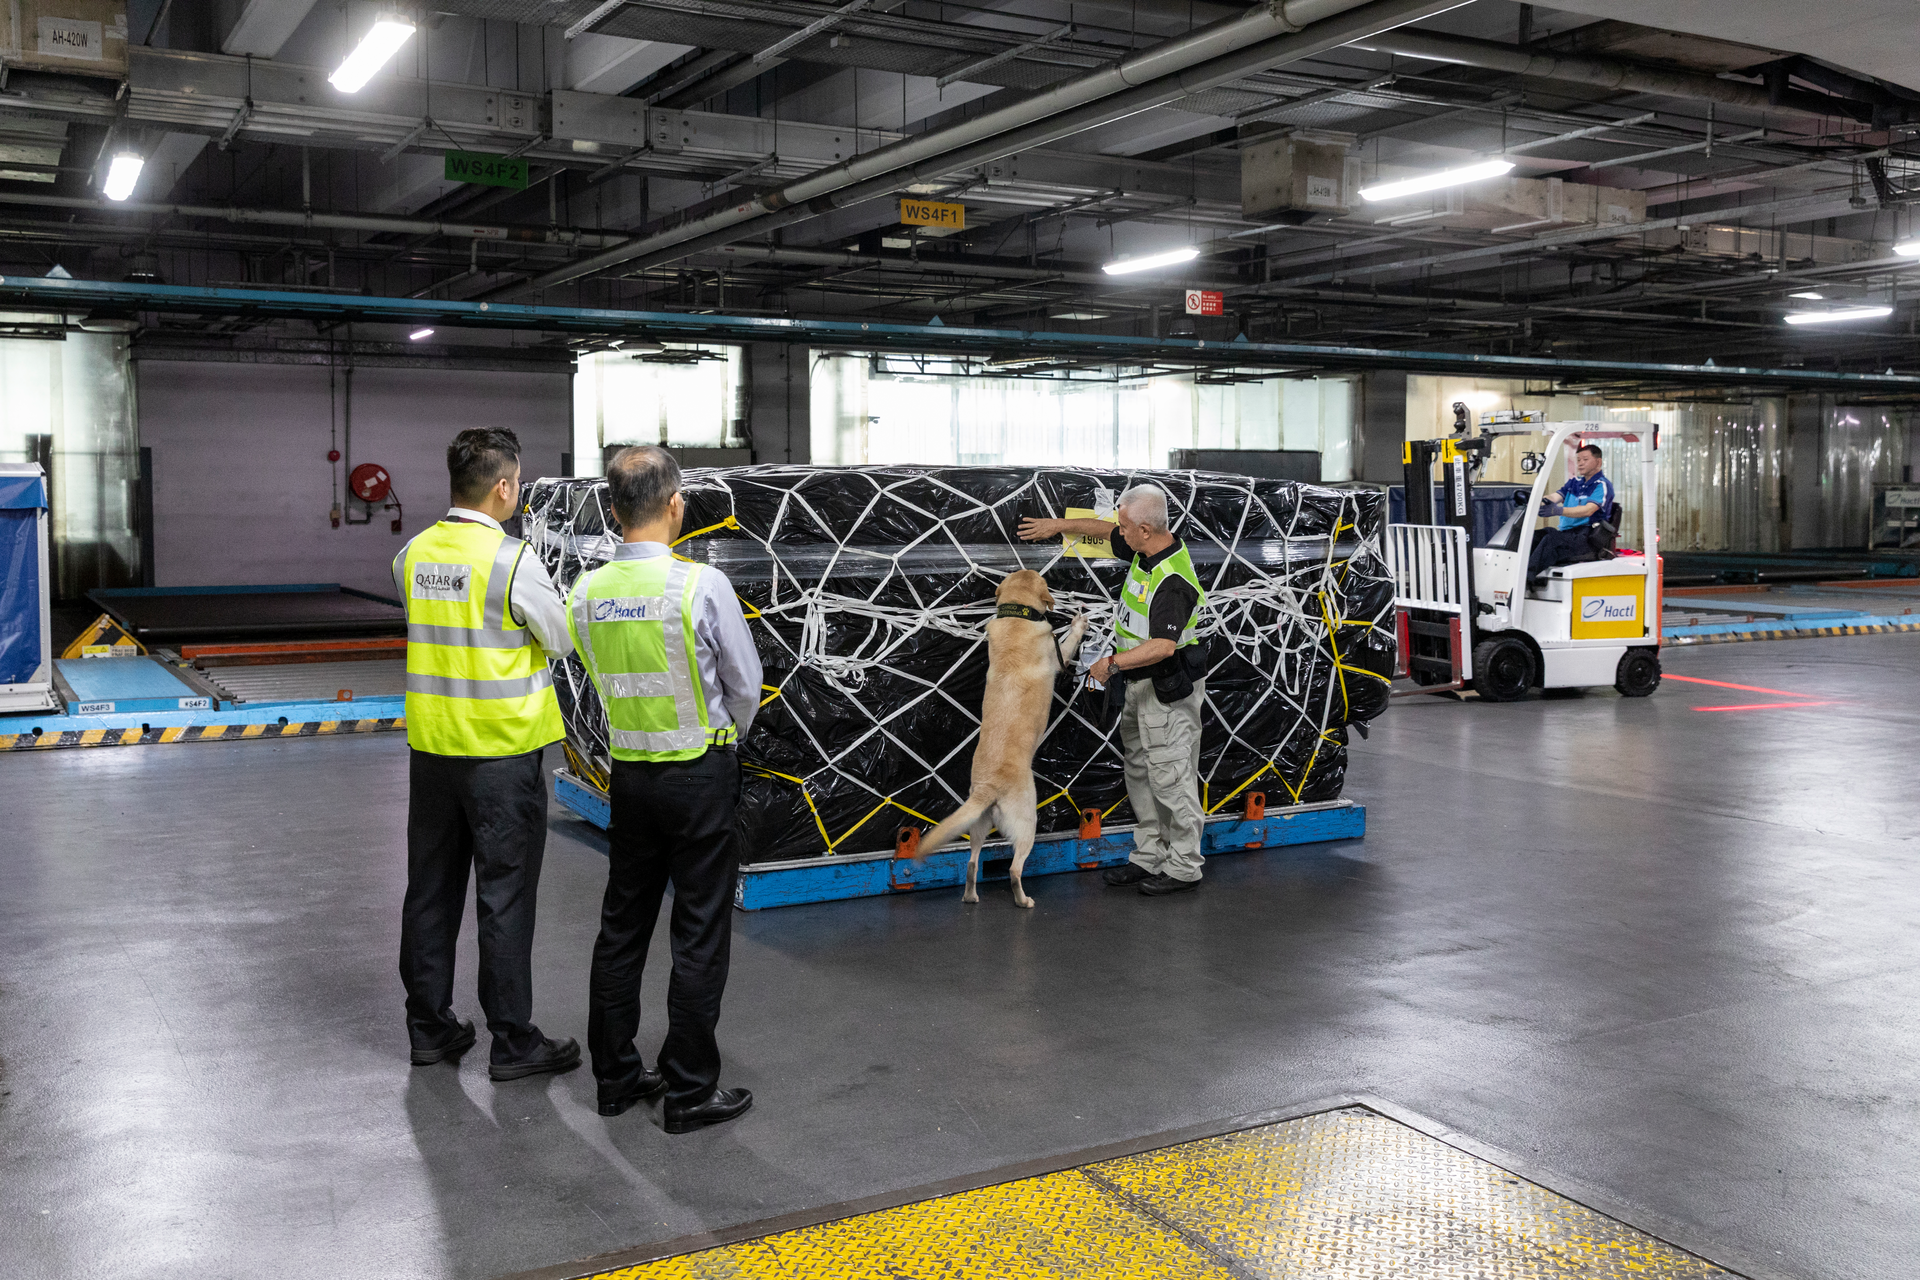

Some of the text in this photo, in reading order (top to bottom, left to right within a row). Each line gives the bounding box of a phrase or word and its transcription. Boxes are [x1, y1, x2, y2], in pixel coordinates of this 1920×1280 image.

[52, 28, 88, 47] AH-420W
[451, 158, 519, 180] WS4F2
[906, 204, 956, 223] WS4F1
[1585, 423, 1599, 431] 226
[1082, 536, 1104, 545] 1905
[415, 573, 450, 587] QATAR
[614, 604, 646, 618] Hactl
[1604, 604, 1634, 617] Hactl
[81, 704, 111, 712] WS4F3
